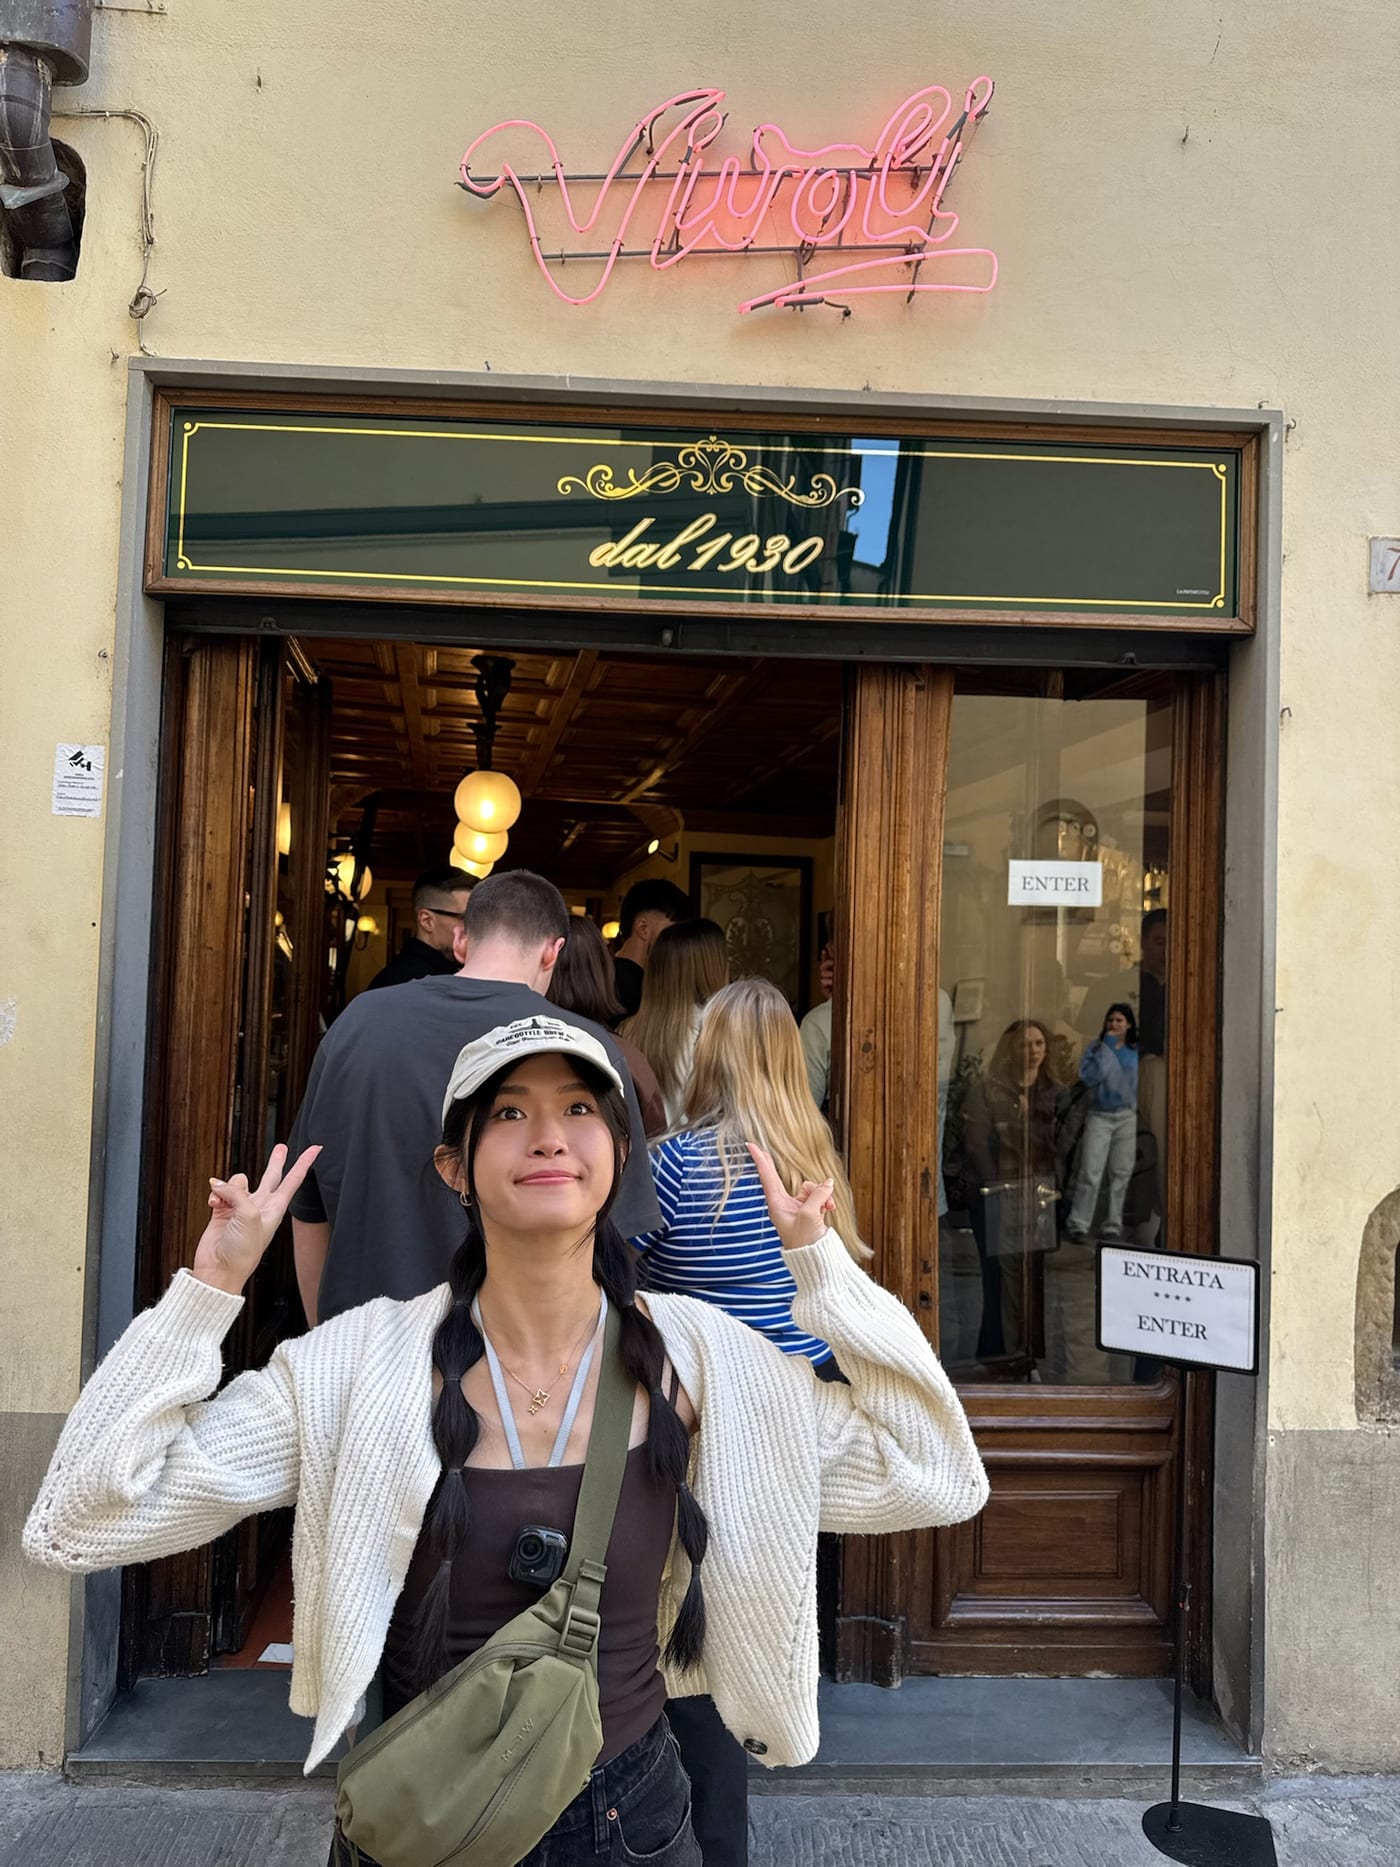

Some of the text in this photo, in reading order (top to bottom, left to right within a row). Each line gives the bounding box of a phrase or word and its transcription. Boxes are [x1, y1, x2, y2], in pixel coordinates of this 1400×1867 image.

[459, 76, 994, 305] Vivoli
[588, 513, 826, 575] dal 1930
[1021, 875, 1091, 893] ENTER
[1122, 1260, 1225, 1290] ENTRATA
[1137, 1314, 1209, 1341] ENTER
